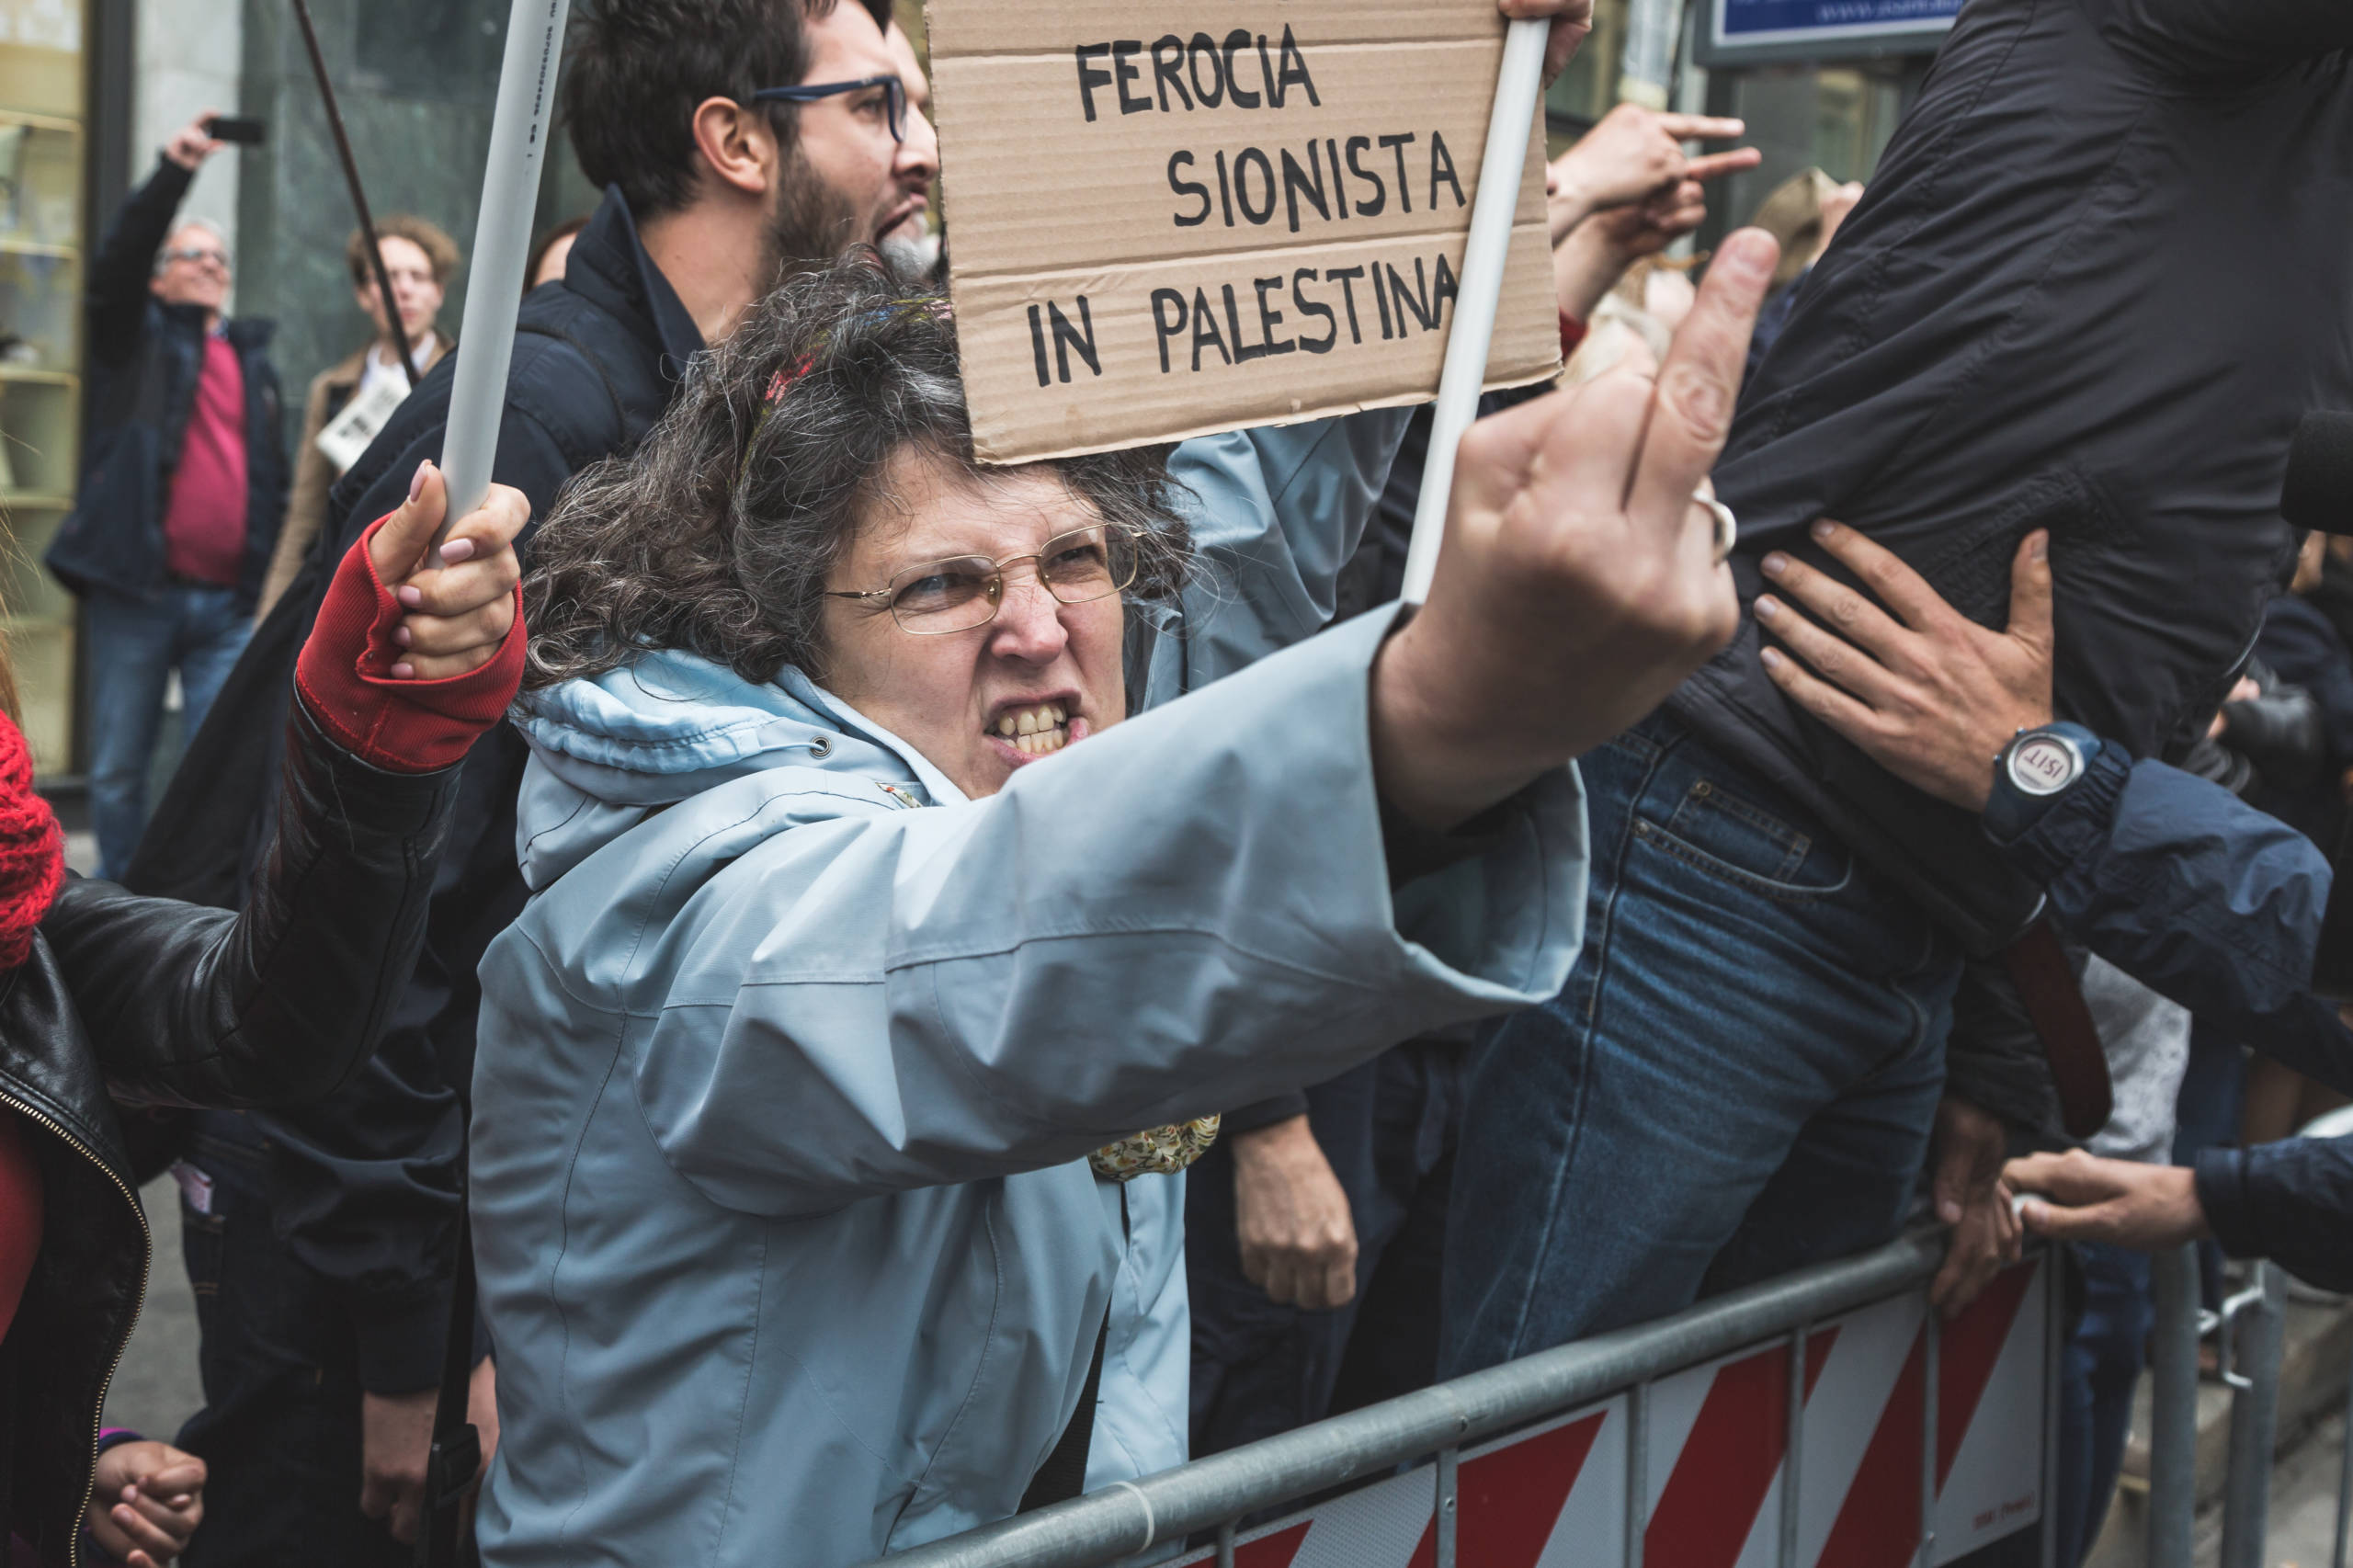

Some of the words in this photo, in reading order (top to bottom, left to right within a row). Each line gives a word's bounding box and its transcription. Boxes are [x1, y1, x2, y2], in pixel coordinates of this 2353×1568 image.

[1075, 23, 1321, 121] FEROCIA
[1166, 131, 1467, 233] SIONISTA
[1027, 294, 1102, 387] IN
[1151, 253, 1458, 373] PALESTINA
